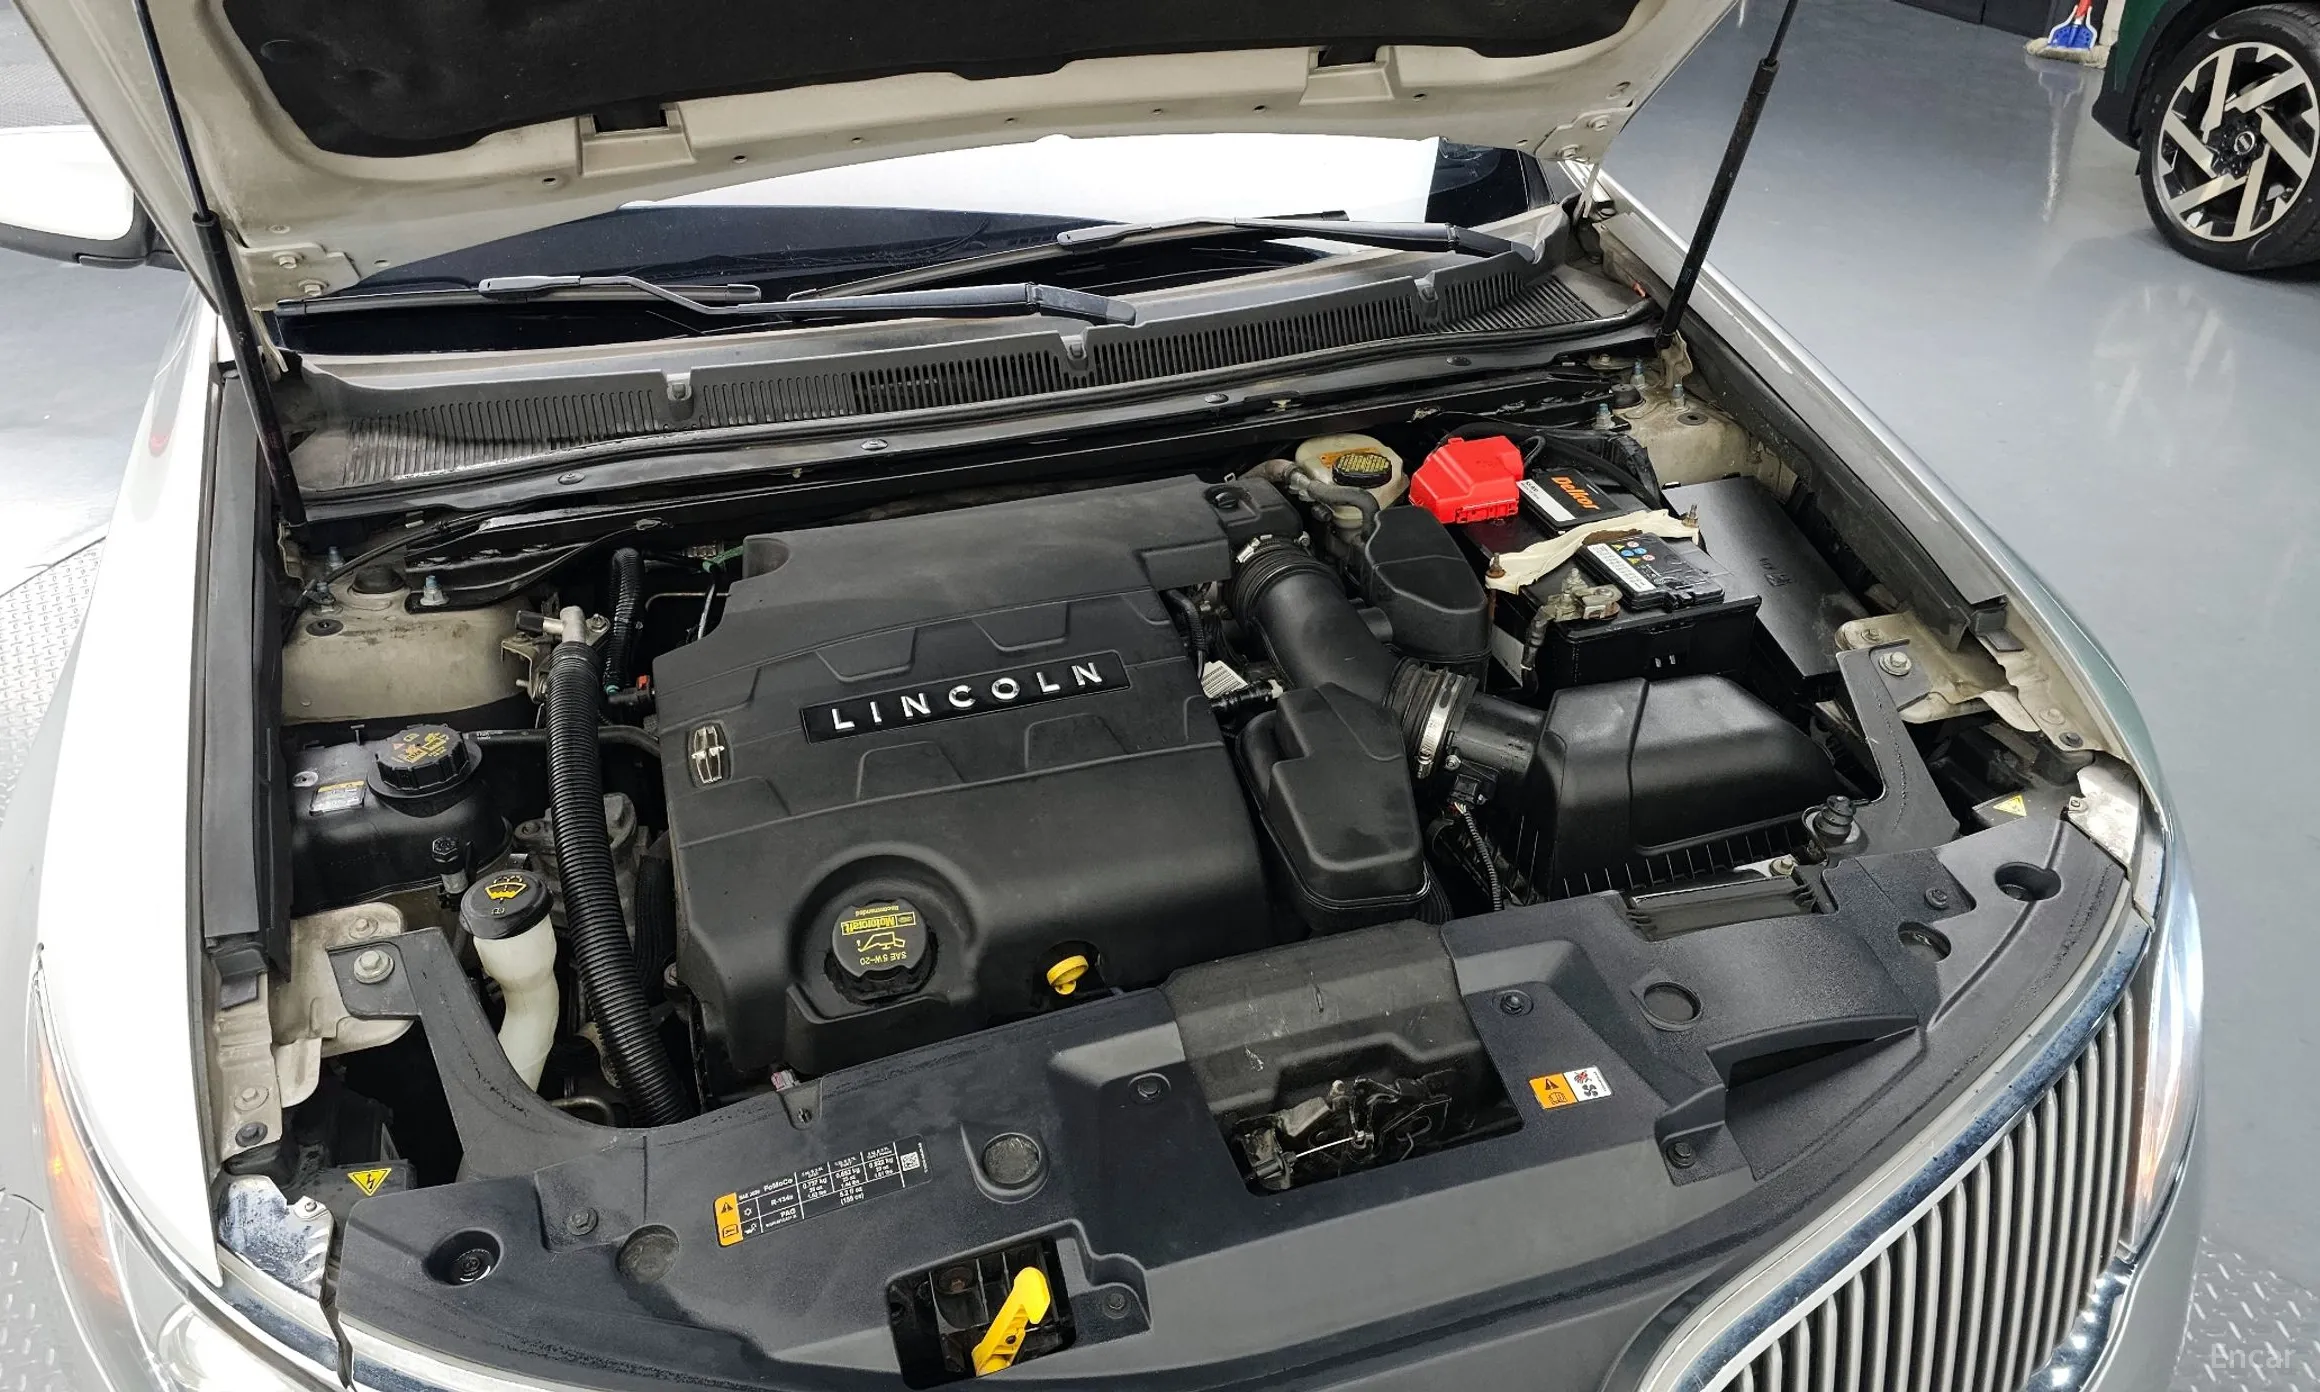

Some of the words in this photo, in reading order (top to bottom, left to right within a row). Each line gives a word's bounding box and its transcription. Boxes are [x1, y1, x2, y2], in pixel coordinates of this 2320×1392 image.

[1551, 476, 1601, 510] Delkor
[831, 662, 1103, 730] LINCOLN
[845, 916, 895, 933] Motorcraft
[859, 954, 888, 966] 5W-20
[890, 952, 907, 960] SAE
[763, 1179, 793, 1192] FoMoCo
[770, 1195, 793, 1206] R-134a
[780, 1207, 797, 1218] PAG
